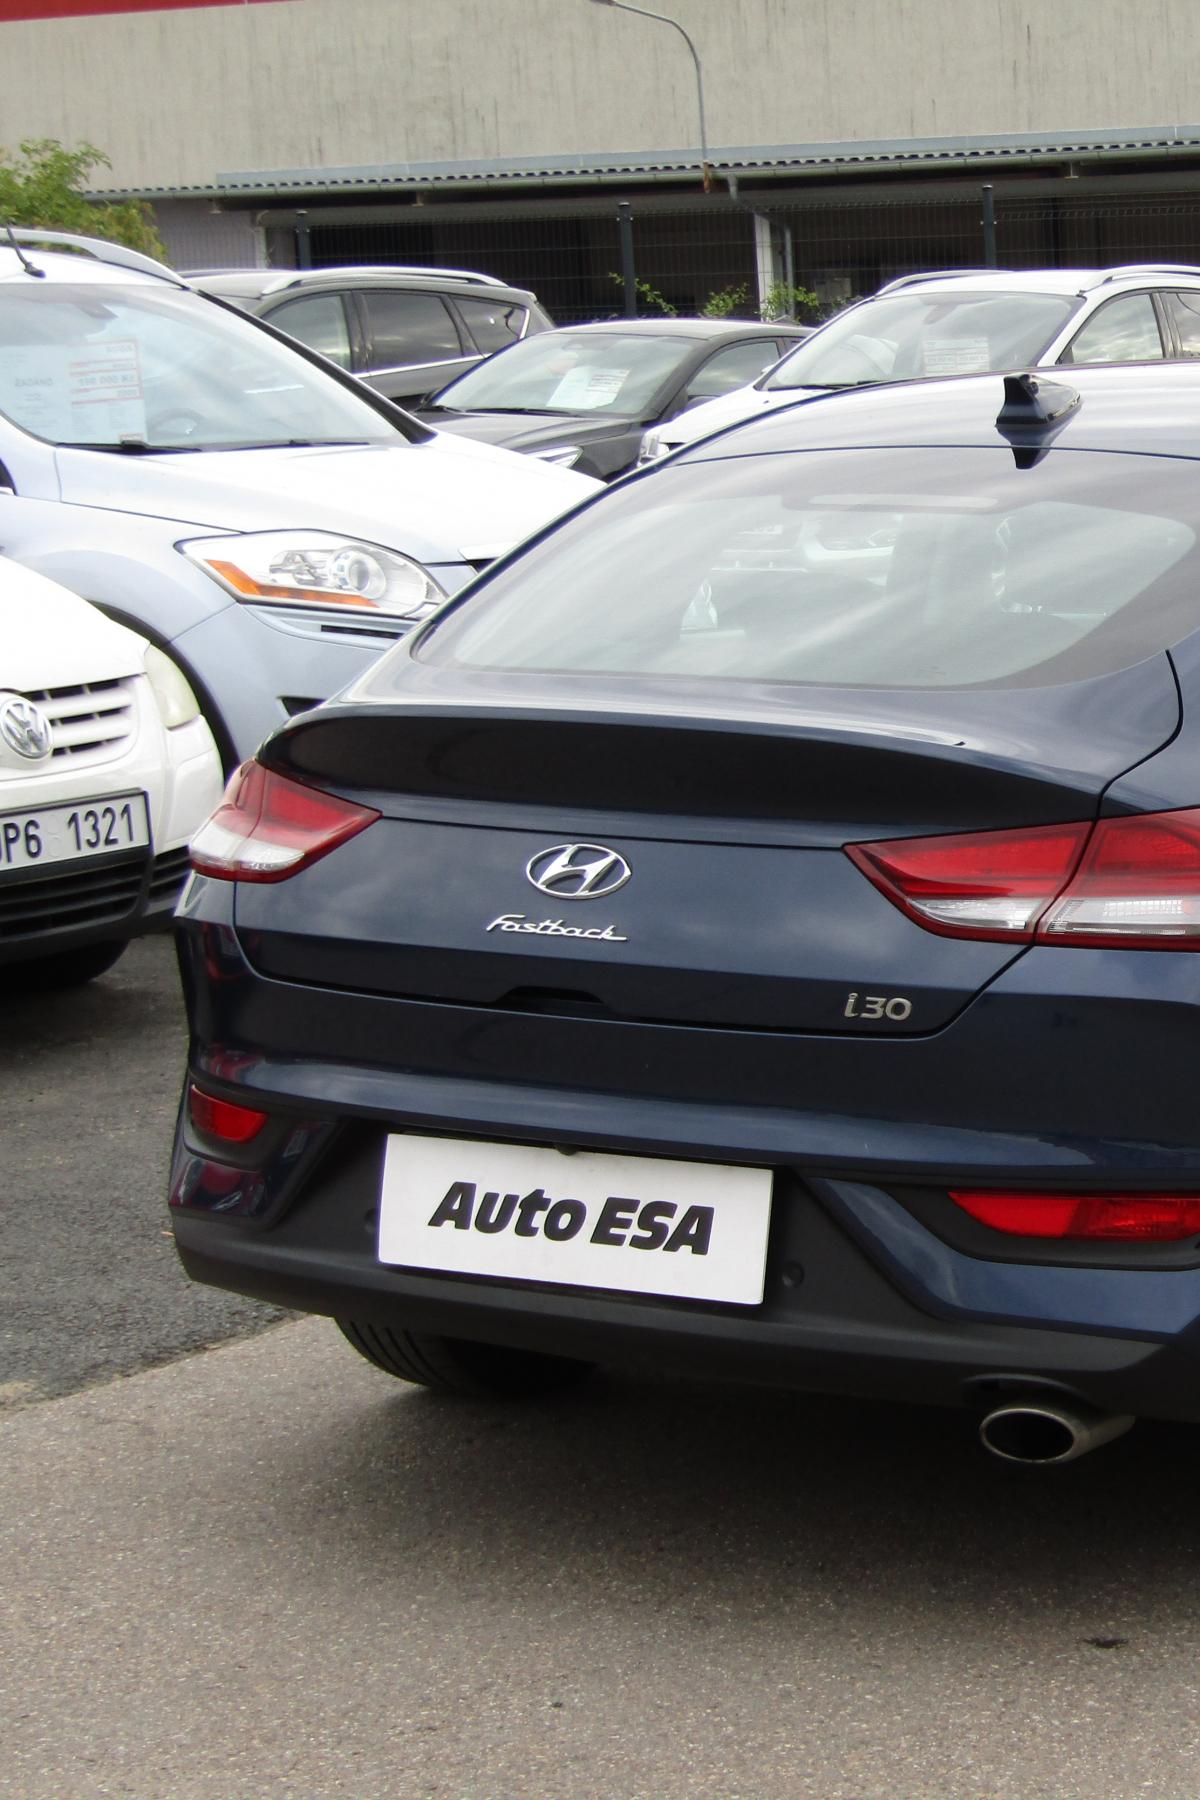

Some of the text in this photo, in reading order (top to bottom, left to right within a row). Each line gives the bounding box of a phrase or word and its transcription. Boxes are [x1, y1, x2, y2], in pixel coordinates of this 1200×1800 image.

[0, 803, 135, 863] P6 1321
[485, 913, 628, 942] Fastback
[843, 992, 913, 1021] i30
[428, 1181, 715, 1256] Auto ESA
